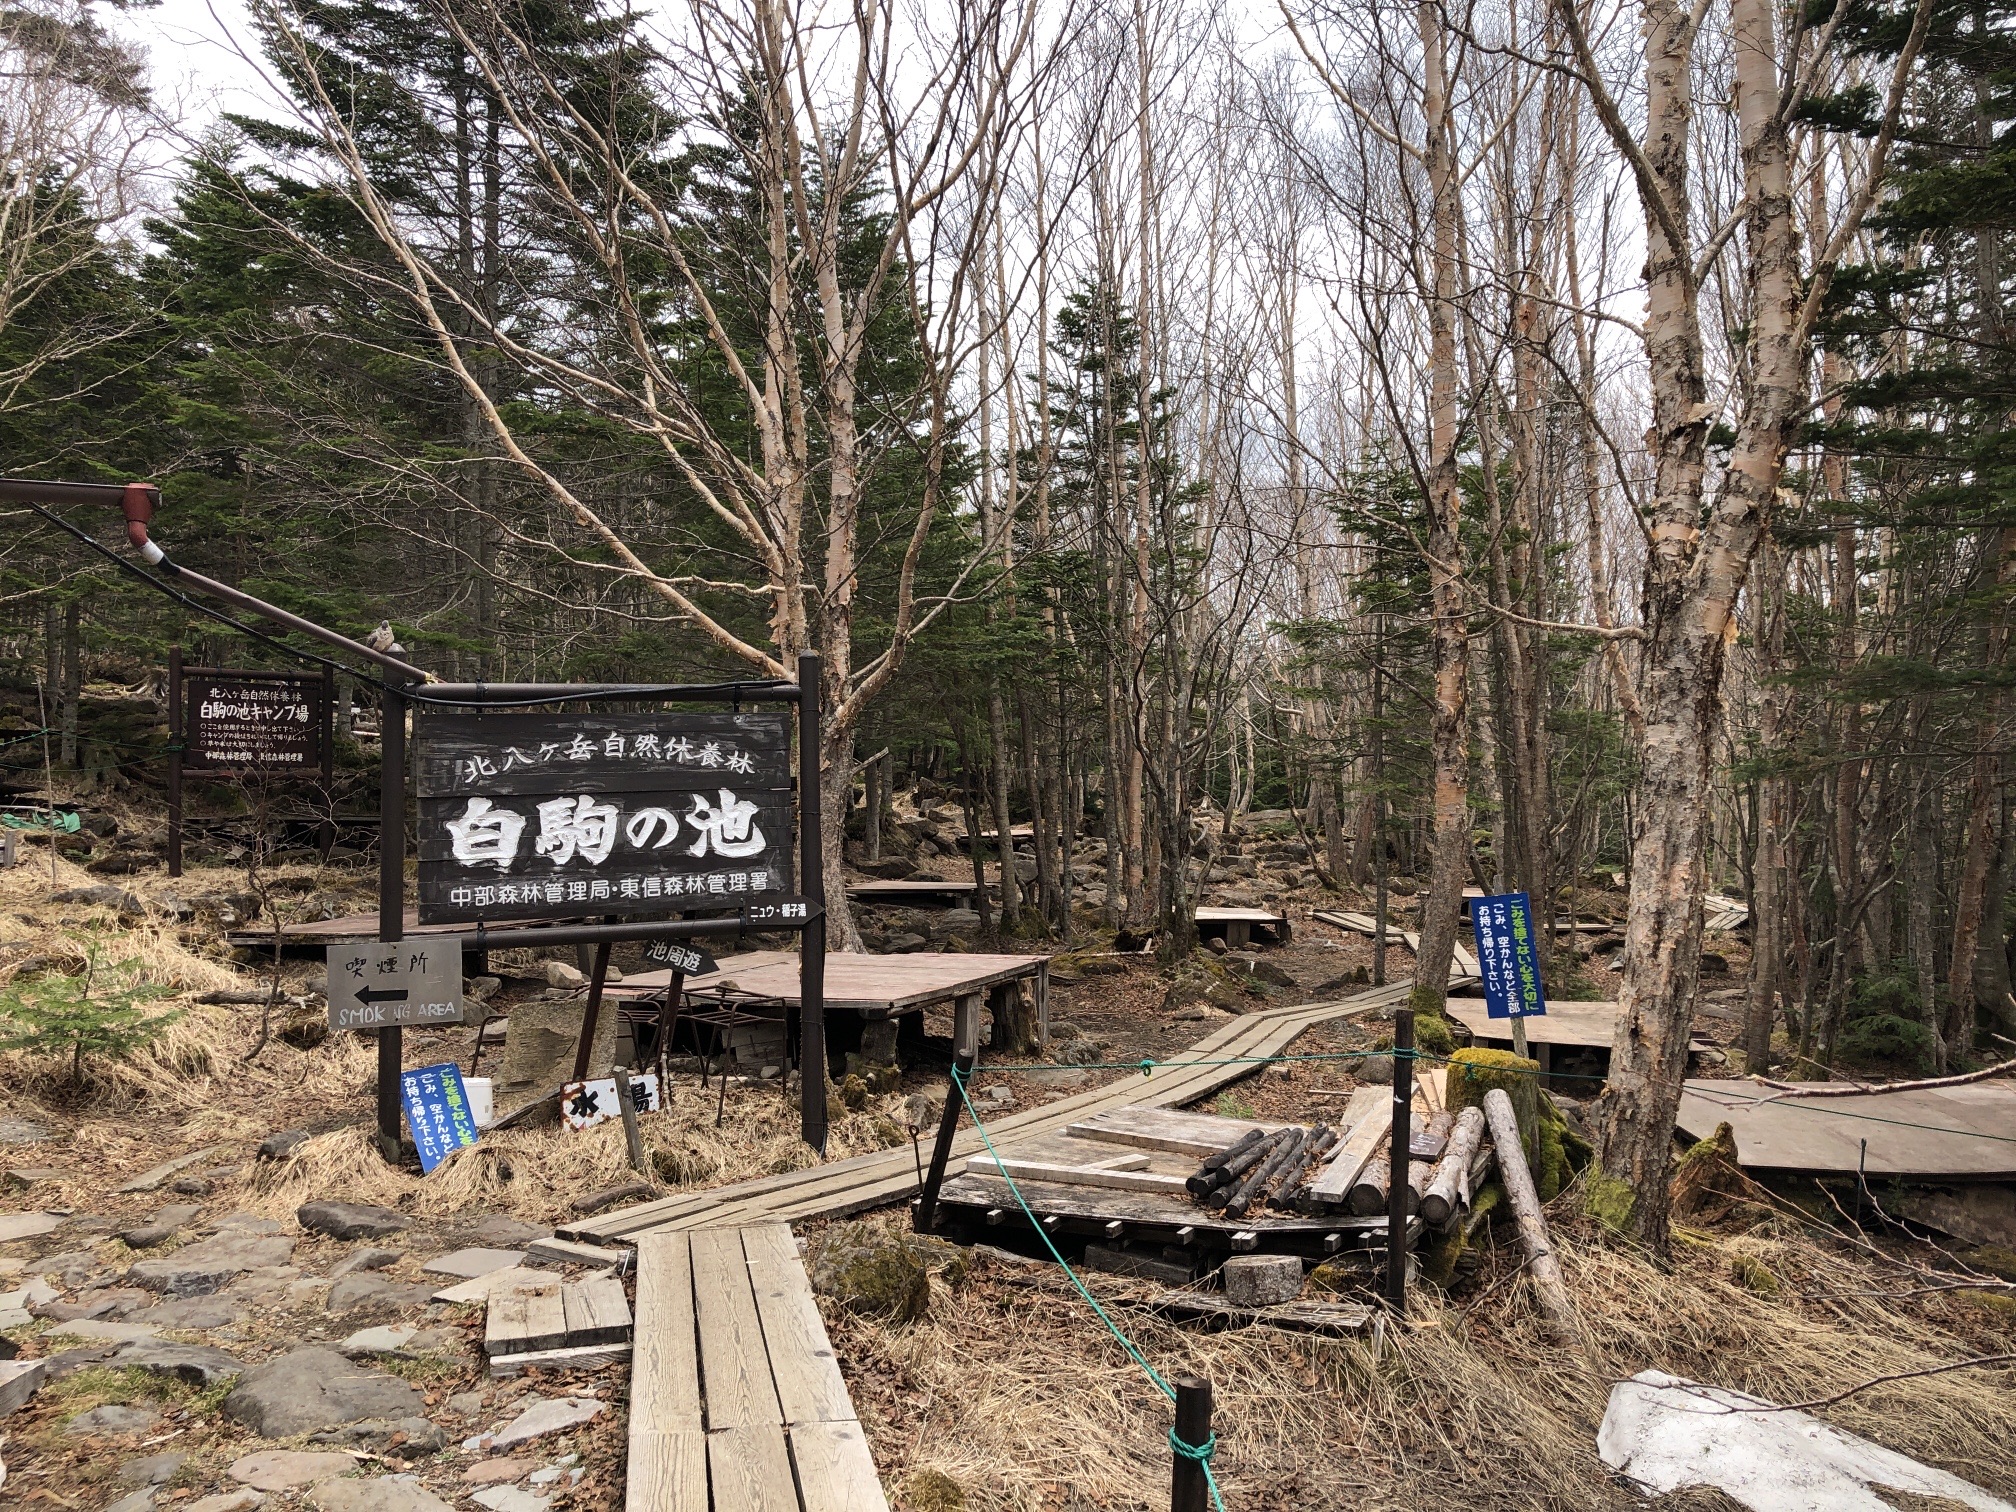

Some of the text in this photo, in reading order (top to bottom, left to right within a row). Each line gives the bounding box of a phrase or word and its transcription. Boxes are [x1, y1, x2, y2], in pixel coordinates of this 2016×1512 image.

[200, 700, 310, 723] 白駒の池キャンプ場
[445, 788, 769, 873] 白駒の池
[750, 903, 807, 918] ニュウ・稲子湯
[346, 952, 429, 978] 喫煙所
[647, 939, 703, 972] 池周遊
[1478, 905, 1503, 998] お持ち帰り下さい。
[417, 1002, 456, 1019] AREA
[404, 1077, 441, 1160] お持ち帰り下さい。
